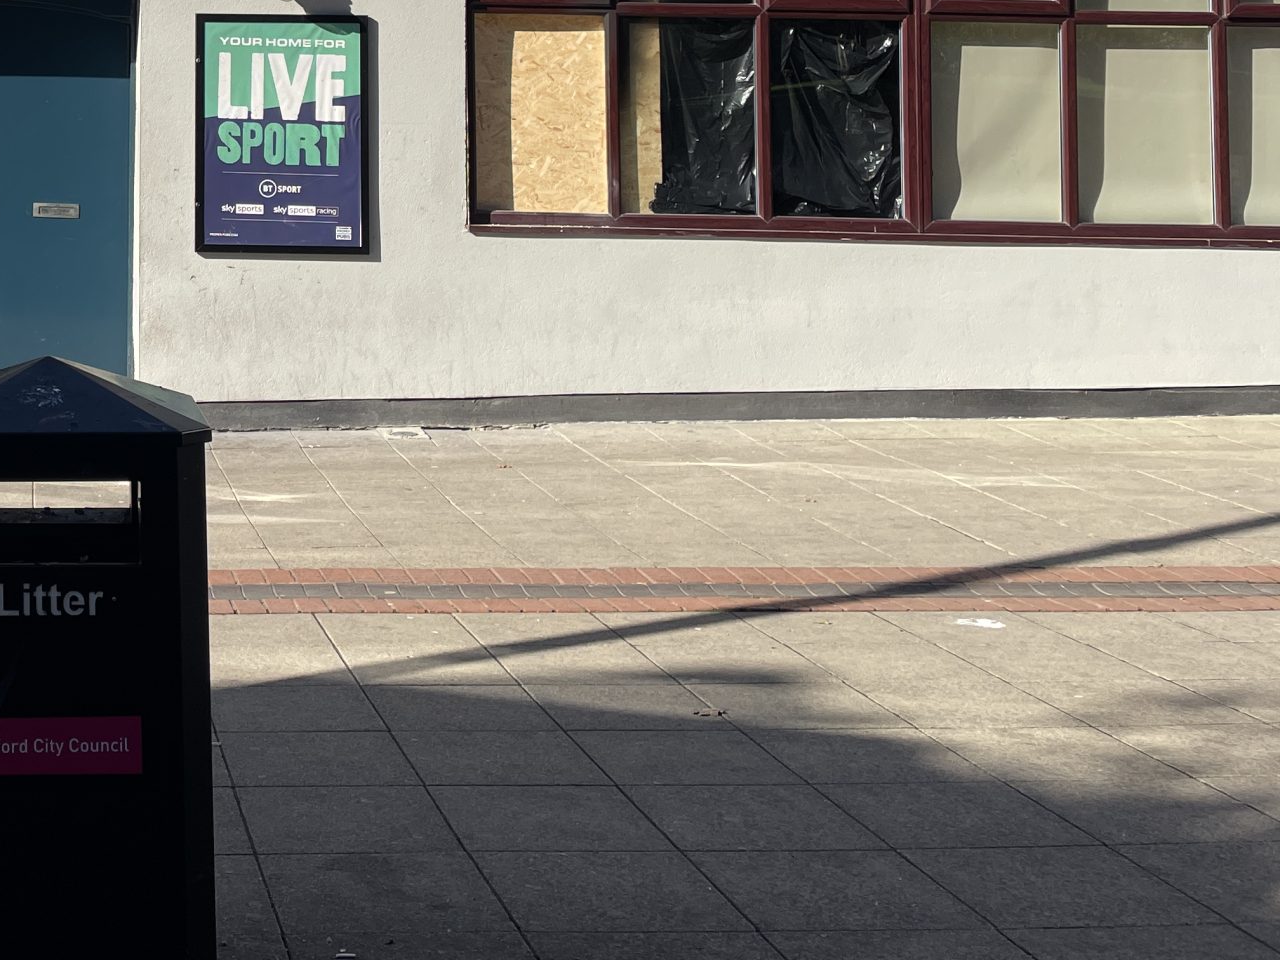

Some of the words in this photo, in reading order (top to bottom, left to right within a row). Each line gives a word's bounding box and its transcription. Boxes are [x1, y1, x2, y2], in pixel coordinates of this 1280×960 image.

[220, 36, 263, 47] YOUR
[265, 37, 312, 48] HOME
[314, 38, 346, 49] FOR
[217, 52, 347, 122] LIVE
[216, 121, 346, 167] SPORT
[262, 184, 273, 193] BT
[277, 185, 302, 194] SPORT
[221, 203, 235, 214] sky
[237, 204, 263, 214] sports
[273, 205, 287, 215] sky
[288, 206, 315, 215] sports
[316, 207, 337, 216] racing
[33, 738, 64, 757] City
[68, 737, 130, 753] Council
